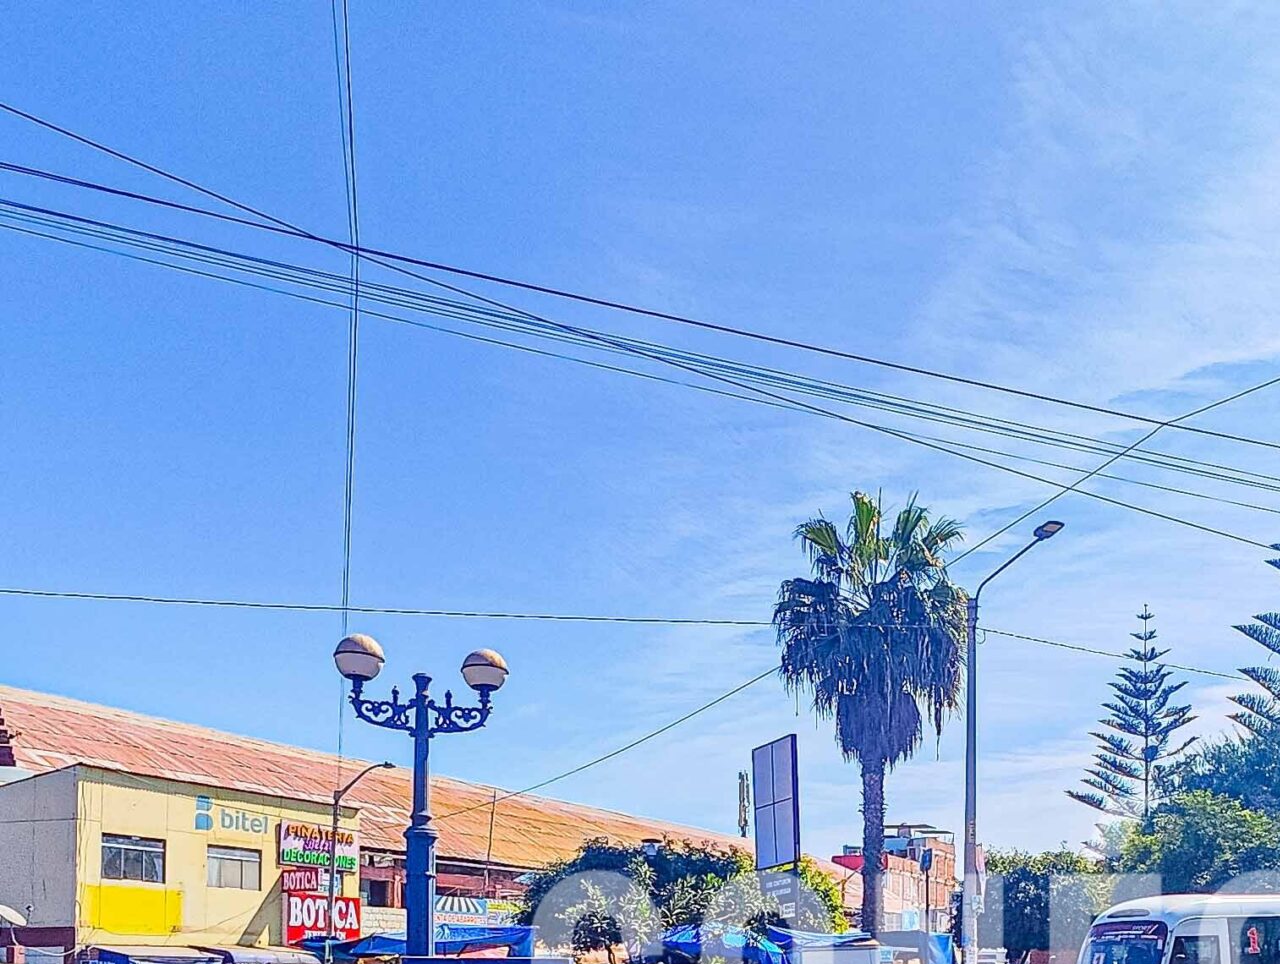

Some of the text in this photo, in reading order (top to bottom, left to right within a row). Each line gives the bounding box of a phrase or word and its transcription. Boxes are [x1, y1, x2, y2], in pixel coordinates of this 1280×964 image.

[221, 809, 268, 834] bitel
[283, 848, 357, 870] DECORACONES
[282, 871, 317, 891] BOTICA
[289, 896, 359, 930] BOTCA
[1247, 927, 1260, 954] 1
